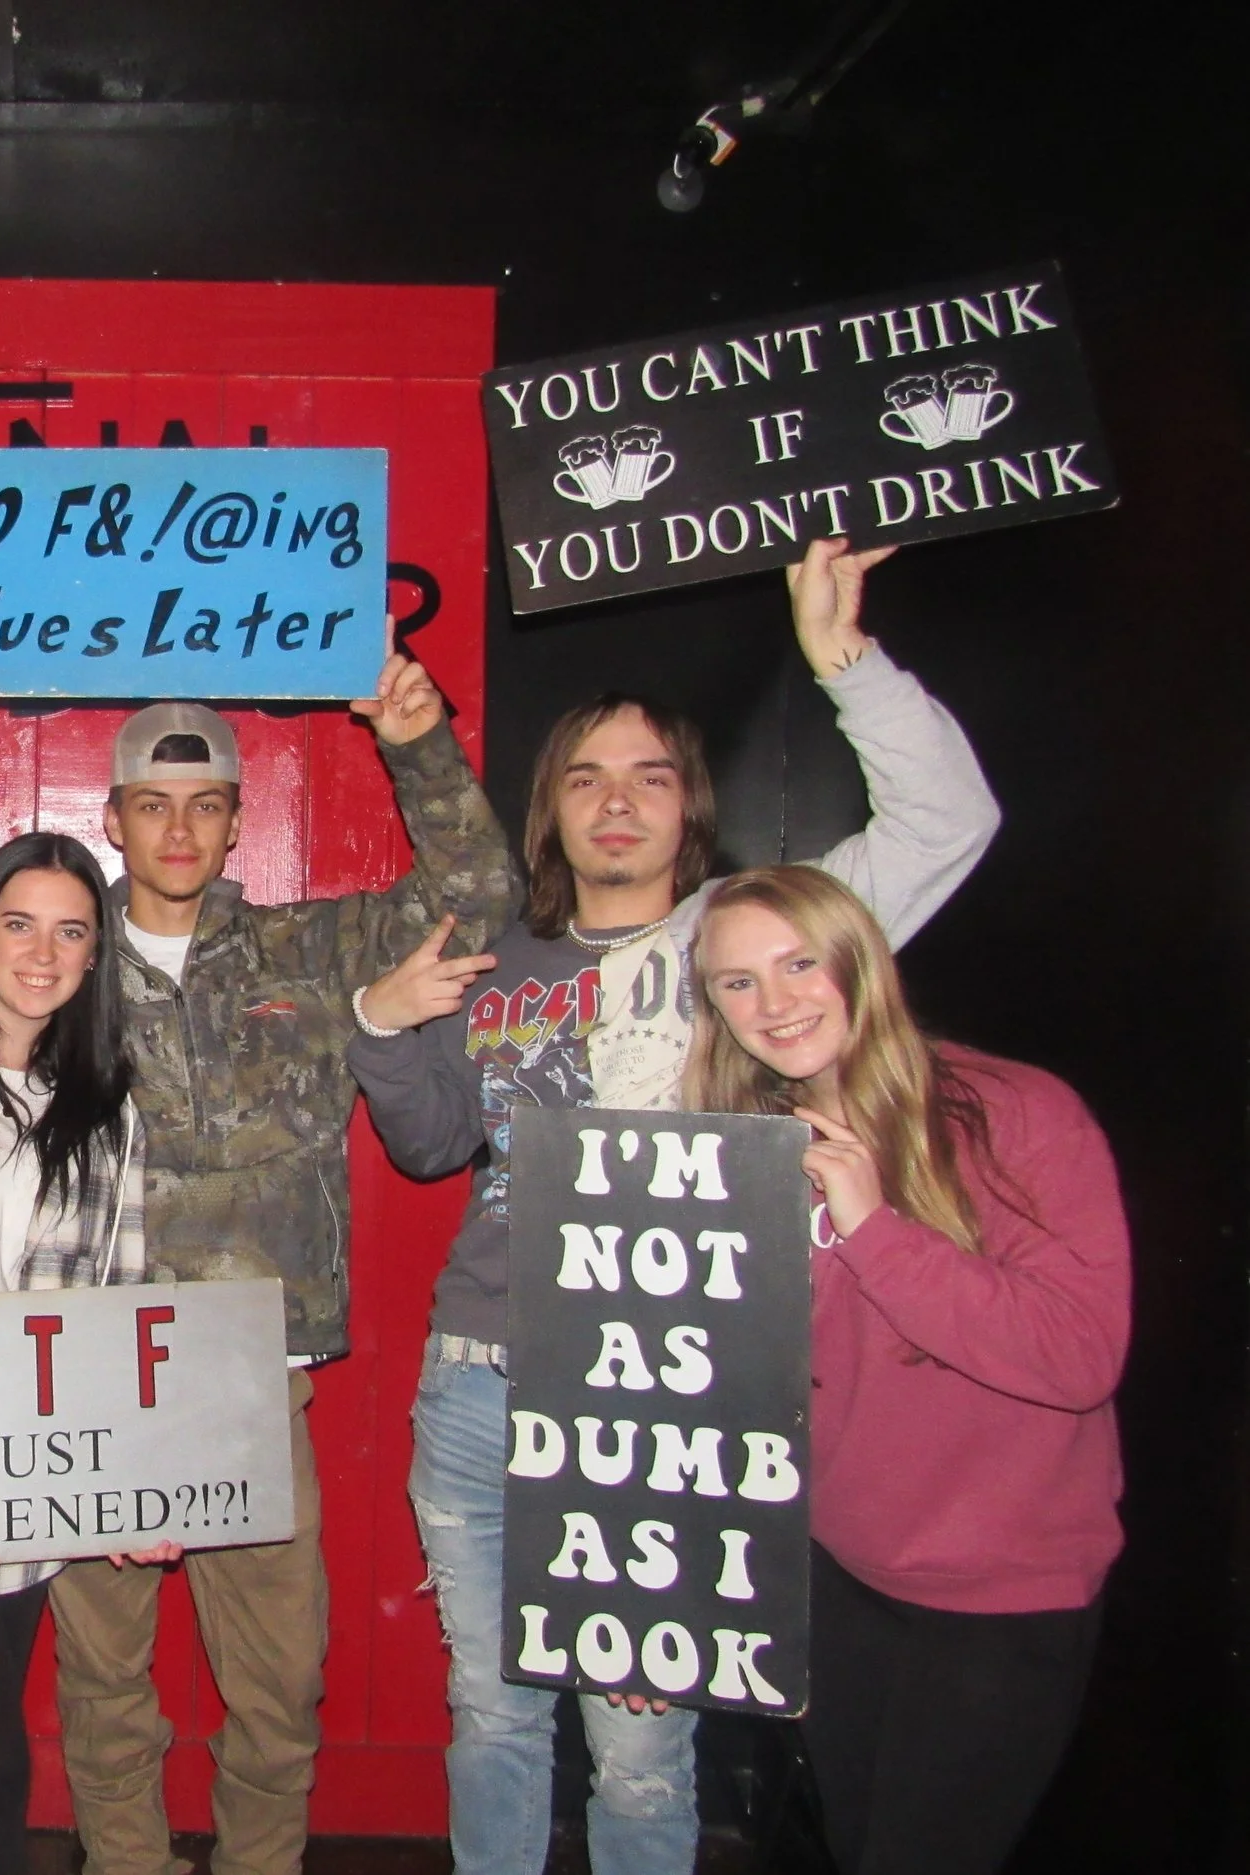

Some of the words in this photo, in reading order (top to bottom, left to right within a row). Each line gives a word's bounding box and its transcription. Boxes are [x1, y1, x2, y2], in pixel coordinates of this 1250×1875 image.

[495, 363, 622, 429] YOU
[641, 325, 822, 403] CAN'T
[839, 283, 1057, 364] THINK
[748, 410, 804, 465] IF
[513, 523, 643, 590] YOU
[660, 484, 849, 565] DON'T
[868, 442, 1100, 527] DRINK
[141, 587, 355, 658] Later
[574, 1129, 728, 1200] I'M
[556, 1223, 748, 1299] NOT
[585, 1321, 714, 1394] AS
[507, 1411, 800, 1502] DUMB
[548, 1512, 679, 1590] AS
[715, 1529, 755, 1599] I
[518, 1604, 786, 1705] LOOK
